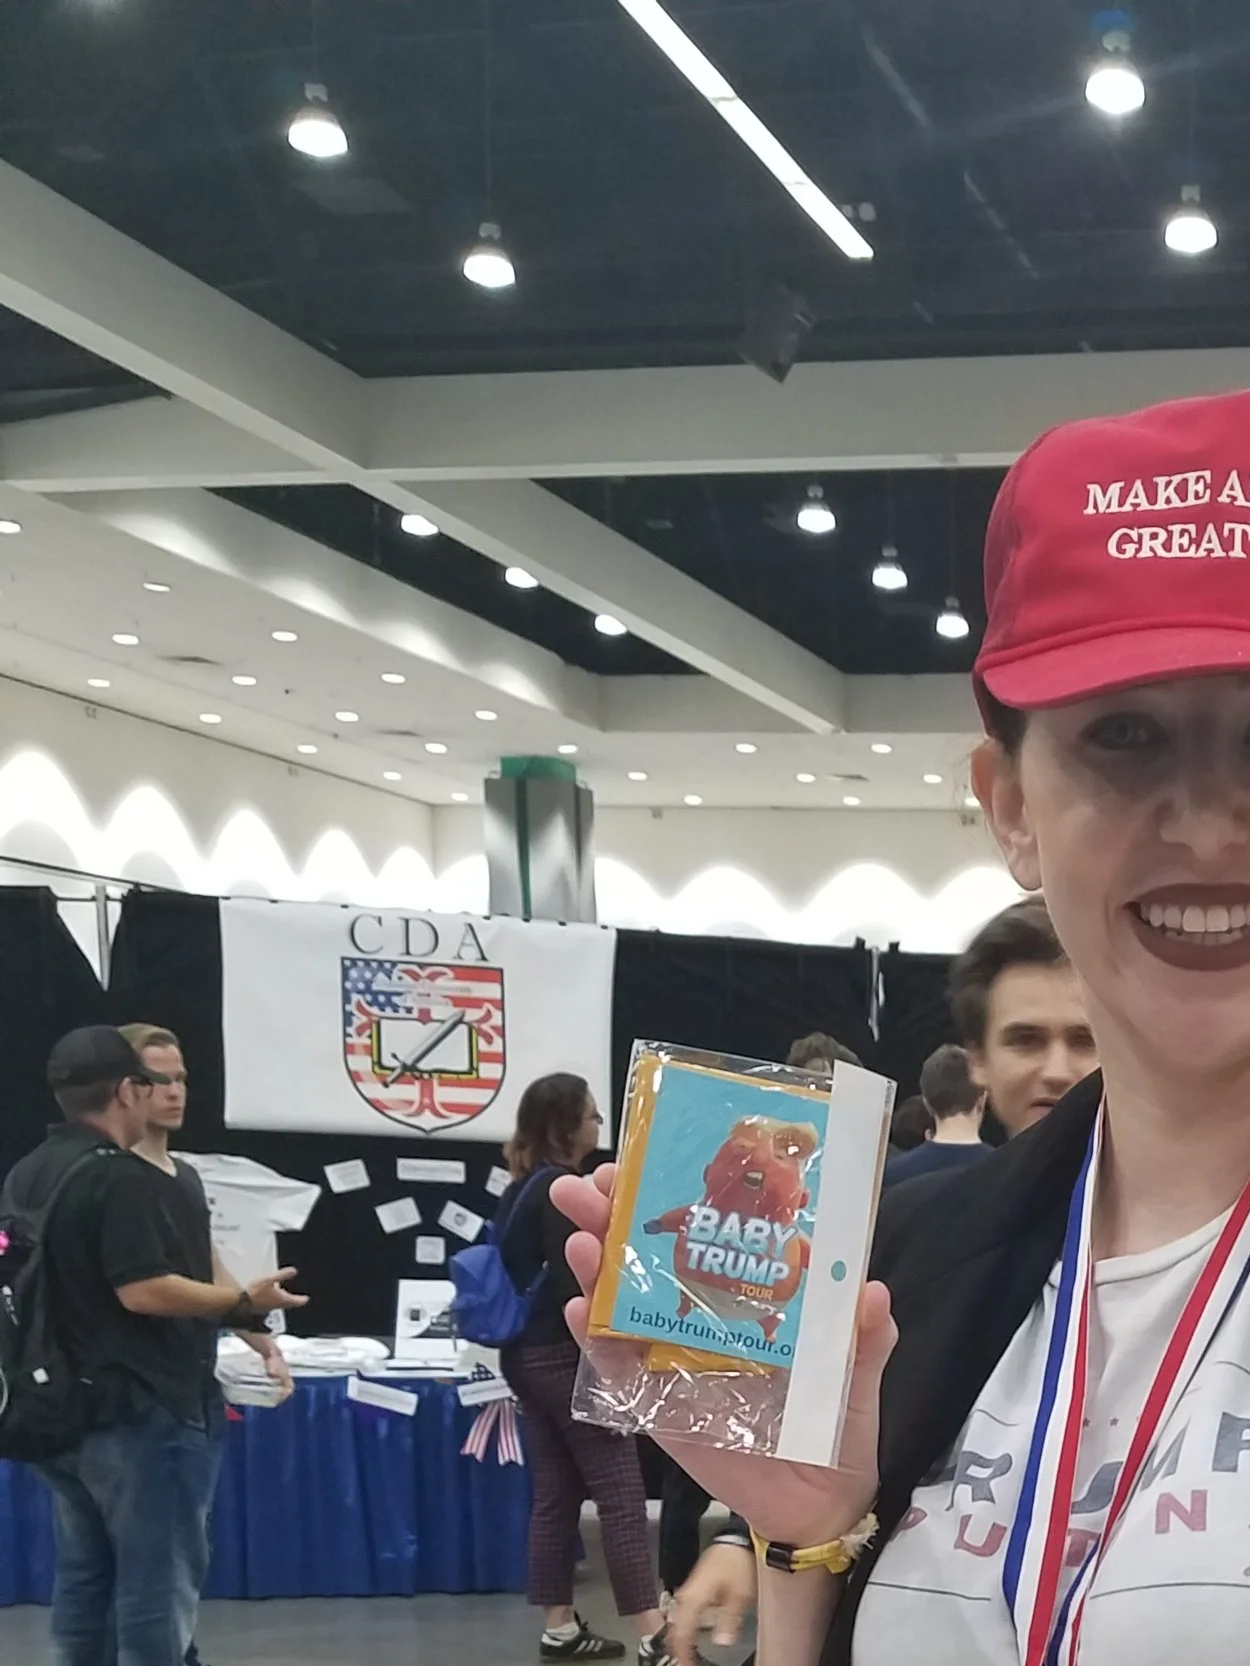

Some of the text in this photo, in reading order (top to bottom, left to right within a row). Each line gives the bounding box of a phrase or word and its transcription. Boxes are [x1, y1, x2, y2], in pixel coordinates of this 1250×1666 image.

[1083, 469, 1211, 516] MAKE
[348, 914, 491, 962] CDA
[687, 1206, 797, 1259] BABY
[686, 1242, 789, 1286] TRUMP
[740, 1283, 774, 1300] TOUR
